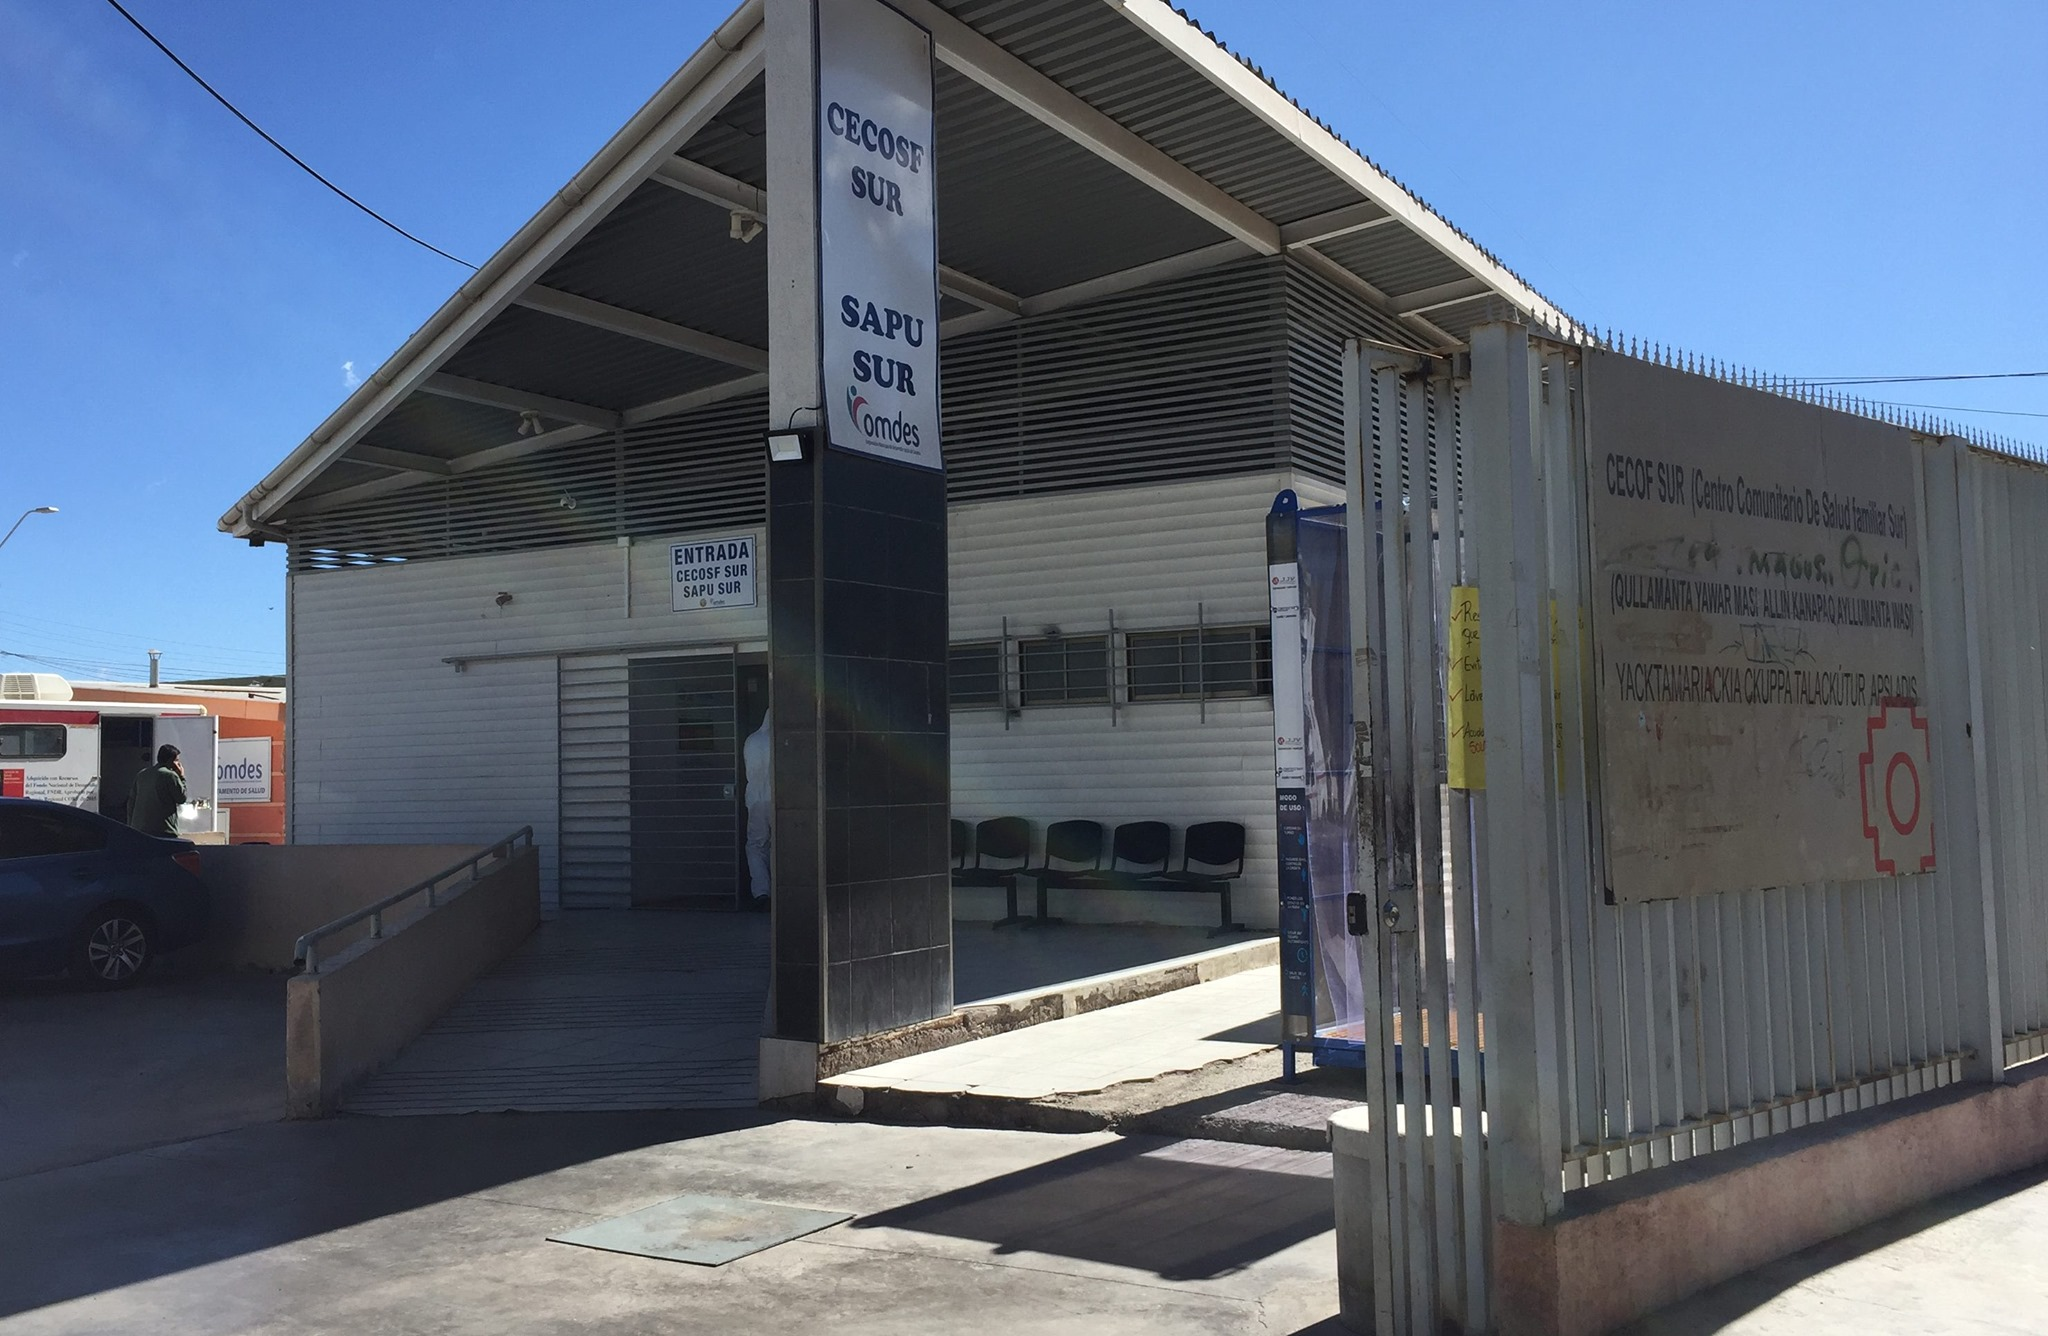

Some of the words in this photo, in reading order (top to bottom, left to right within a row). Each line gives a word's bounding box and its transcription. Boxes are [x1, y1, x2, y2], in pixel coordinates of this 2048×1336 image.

[827, 102, 924, 174] CECOSF
[852, 165, 904, 217] SUR
[841, 295, 924, 347] SAPU
[853, 350, 916, 396] SUR
[1606, 453, 1653, 500] CECOF
[1658, 461, 1685, 505] SUR
[1691, 467, 1734, 518] (Centro
[1737, 475, 1804, 524] Comunitario
[1805, 488, 1820, 526] De
[1822, 491, 1851, 531] Salud
[674, 541, 749, 565] ENTRADA
[676, 566, 721, 582] CECOSF
[724, 564, 748, 578] SUR
[683, 584, 714, 598] SAPU
[718, 581, 741, 595] SUR
[1611, 573, 1693, 615] (QULLAMANTA
[1694, 581, 1732, 615] YAWAR
[1763, 588, 1791, 620] ALLIN
